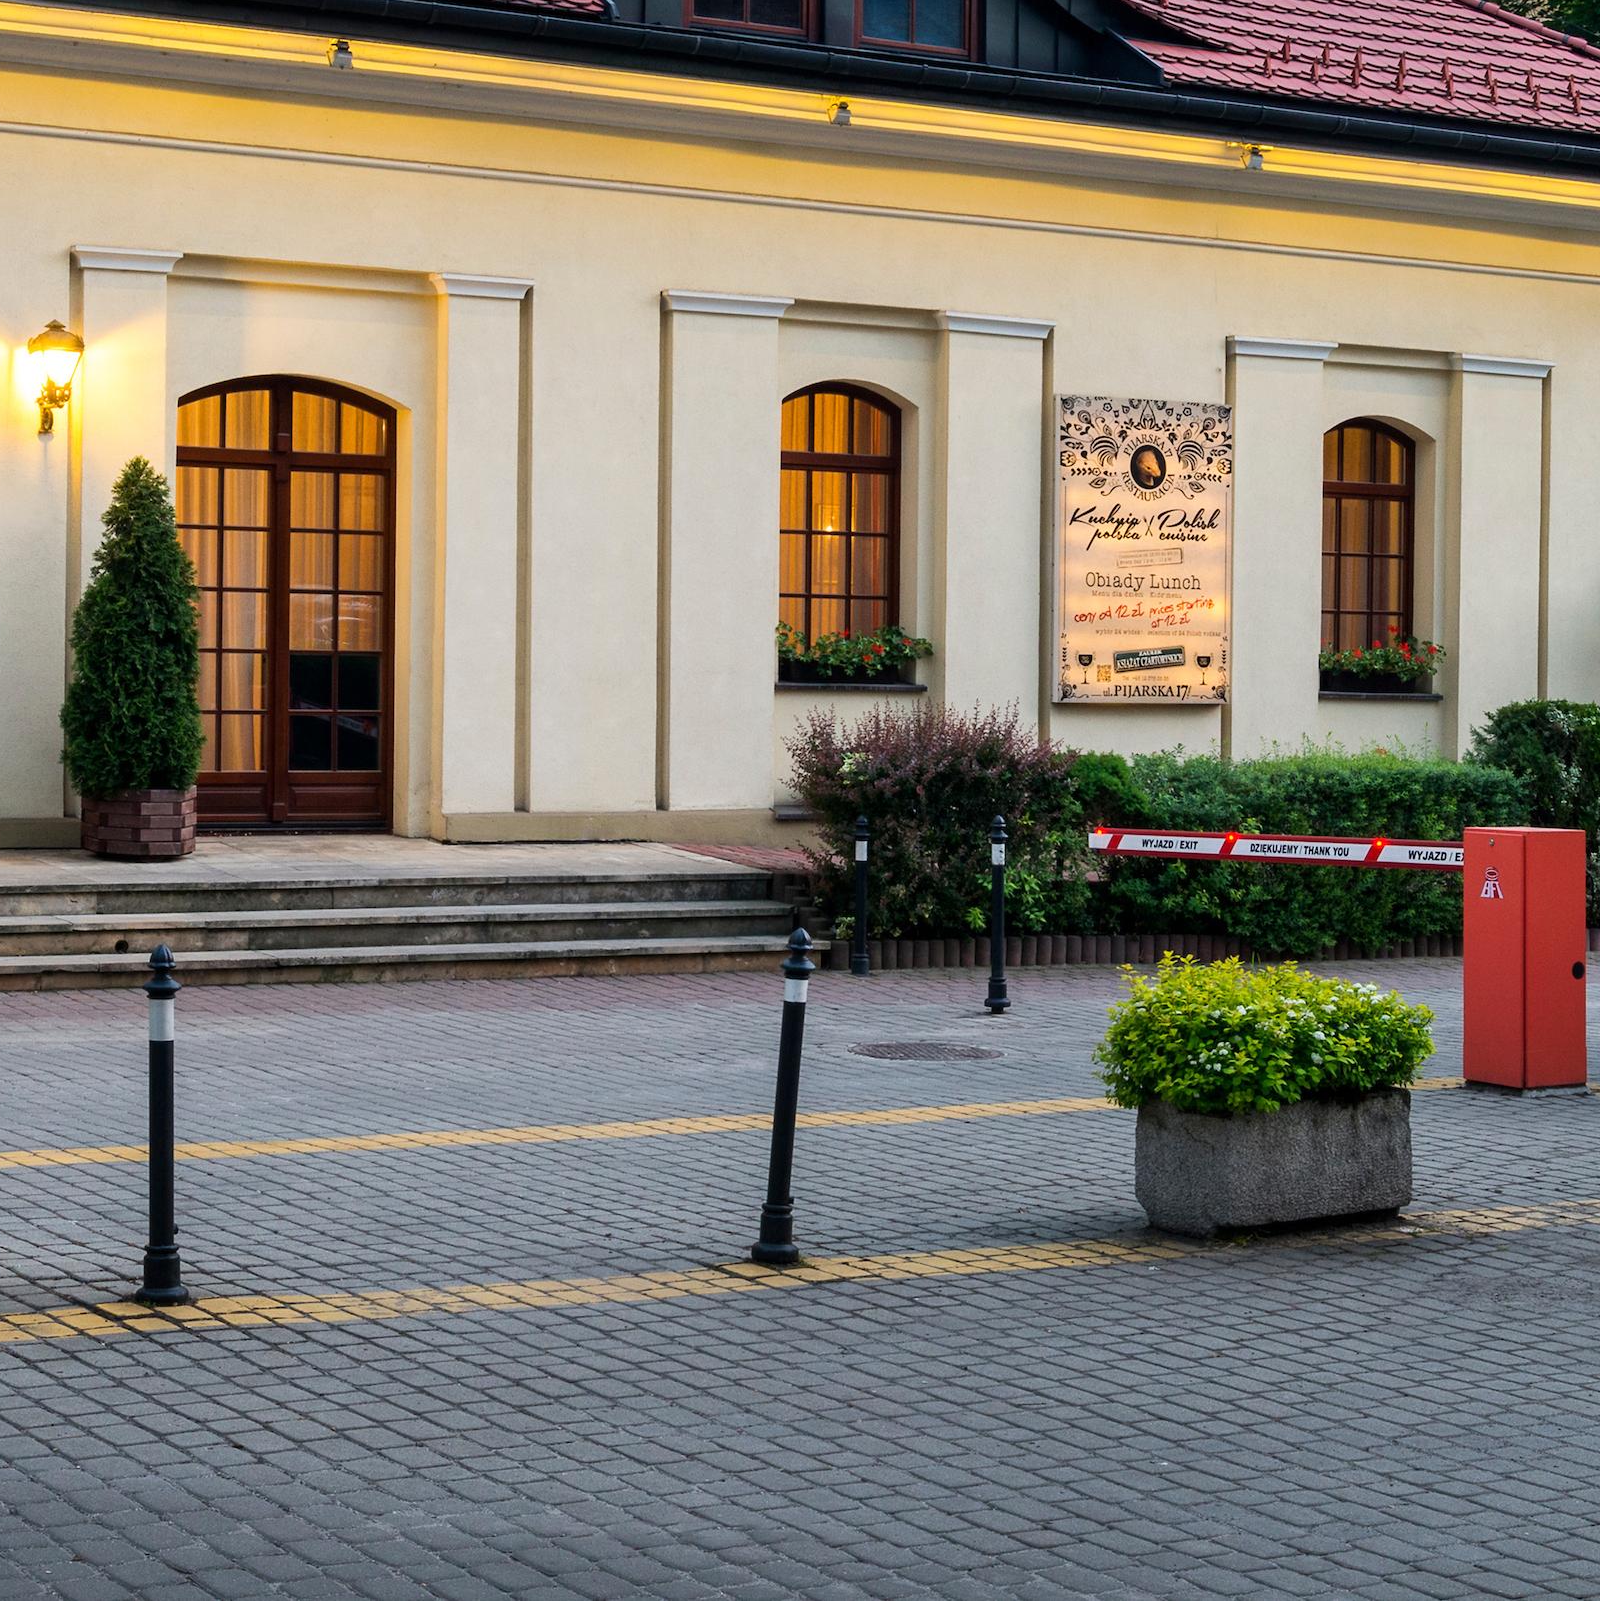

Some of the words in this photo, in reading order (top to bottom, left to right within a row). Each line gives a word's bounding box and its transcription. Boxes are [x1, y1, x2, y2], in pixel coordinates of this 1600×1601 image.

[1123, 434, 1165, 456] PIJARSKA
[1164, 448, 1173, 458] 17
[1121, 471, 1175, 501] RESTAURACJA
[1069, 503, 1141, 527] Kuchnia
[1157, 508, 1221, 530] Polish
[1086, 522, 1141, 551] polska
[1159, 528, 1208, 541] cuisine
[1085, 571, 1145, 592] Obiady
[1150, 573, 1201, 590] Lunch
[1074, 612, 1097, 623] ceny
[1099, 606, 1112, 620] od
[1115, 604, 1130, 618] 12
[1131, 601, 1144, 617] zł
[1149, 601, 1174, 618] prices
[1151, 618, 1164, 628] at
[1164, 614, 1178, 626] 12
[1179, 611, 1191, 625] zł
[1103, 687, 1113, 697] ul.
[1114, 685, 1174, 698] PIJARSKA
[1142, 839, 1174, 849] WYJAZD
[1180, 841, 1198, 850] EXIT
[1250, 843, 1298, 855] DZIĘKUJEMY
[1304, 846, 1331, 855] THANK
[1333, 847, 1350, 857] YOU
[1408, 850, 1447, 861] WYJAZD
